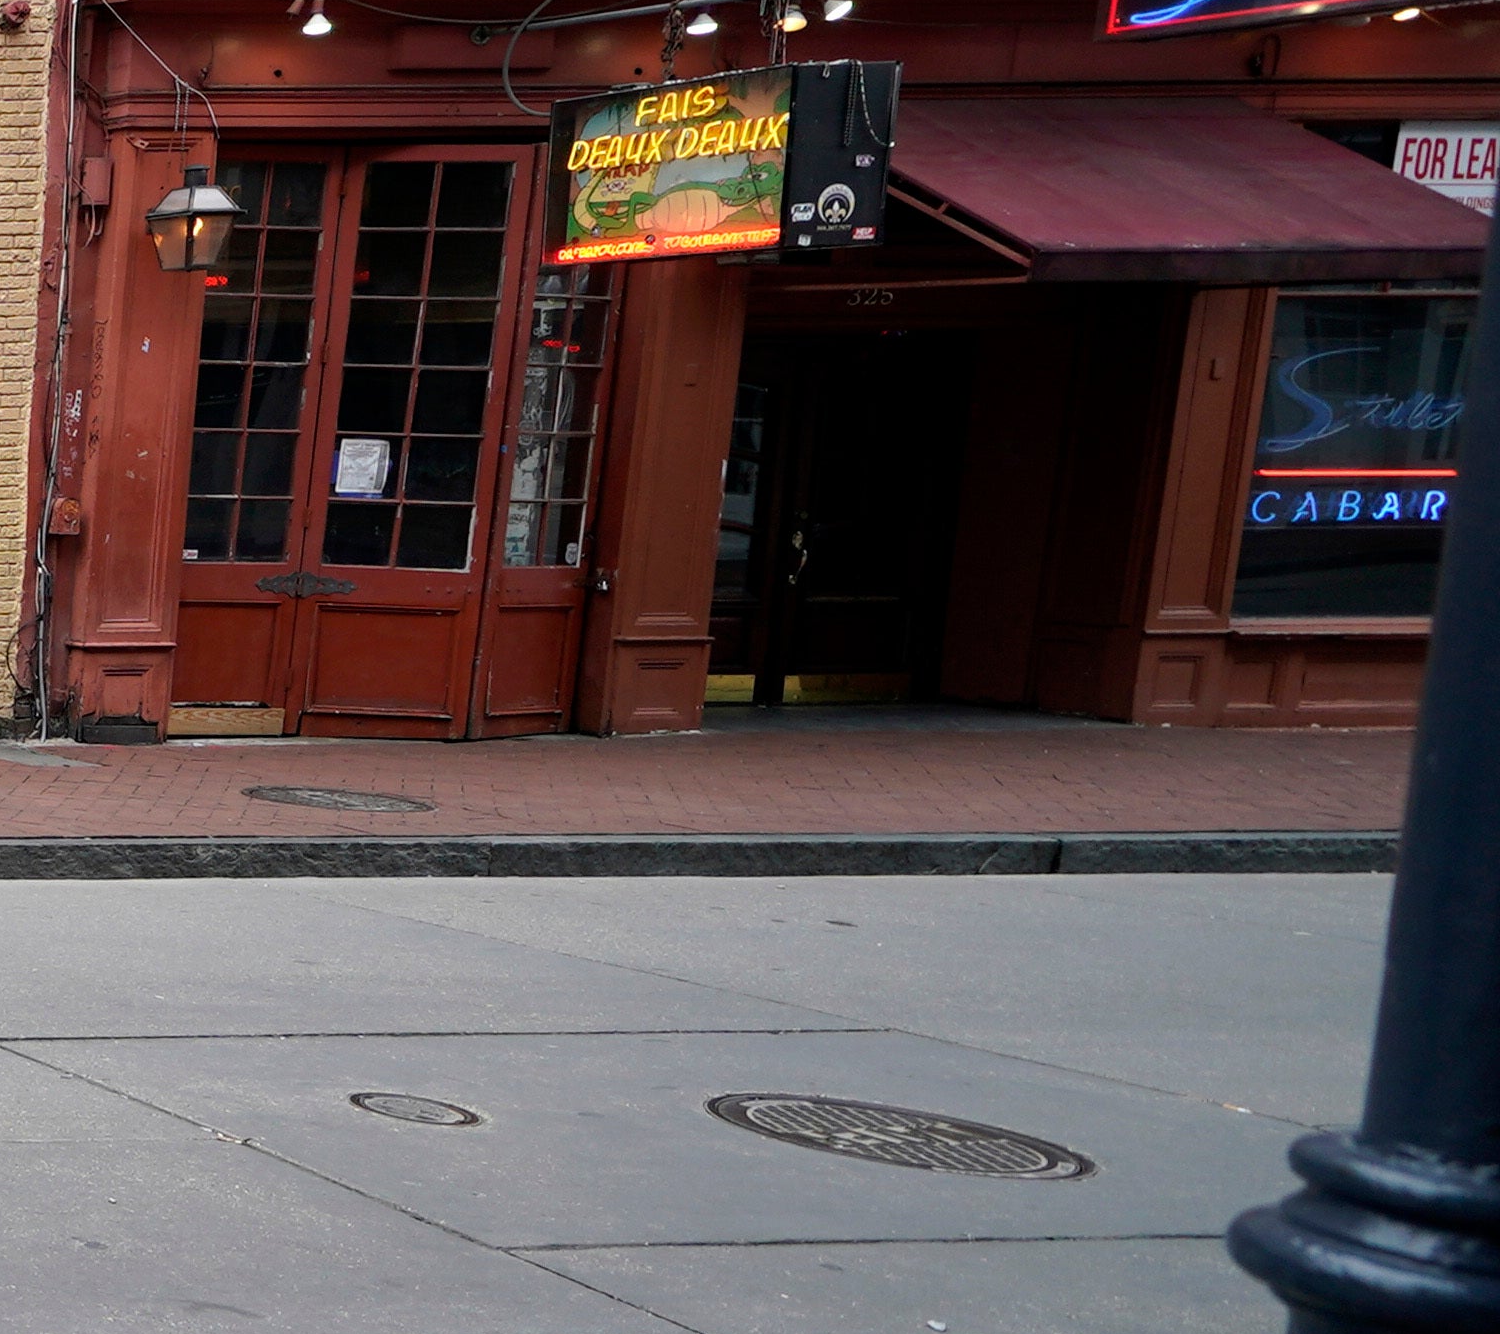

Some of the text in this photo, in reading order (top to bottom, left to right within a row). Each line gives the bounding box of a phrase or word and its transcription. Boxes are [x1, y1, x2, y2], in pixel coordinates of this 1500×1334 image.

[634, 85, 716, 127] FAIS
[567, 112, 790, 171] DEAUX DEAUX
[1400, 137, 1448, 179] FOR
[846, 288, 894, 306] 325
[1251, 489, 1447, 523] CABAR
